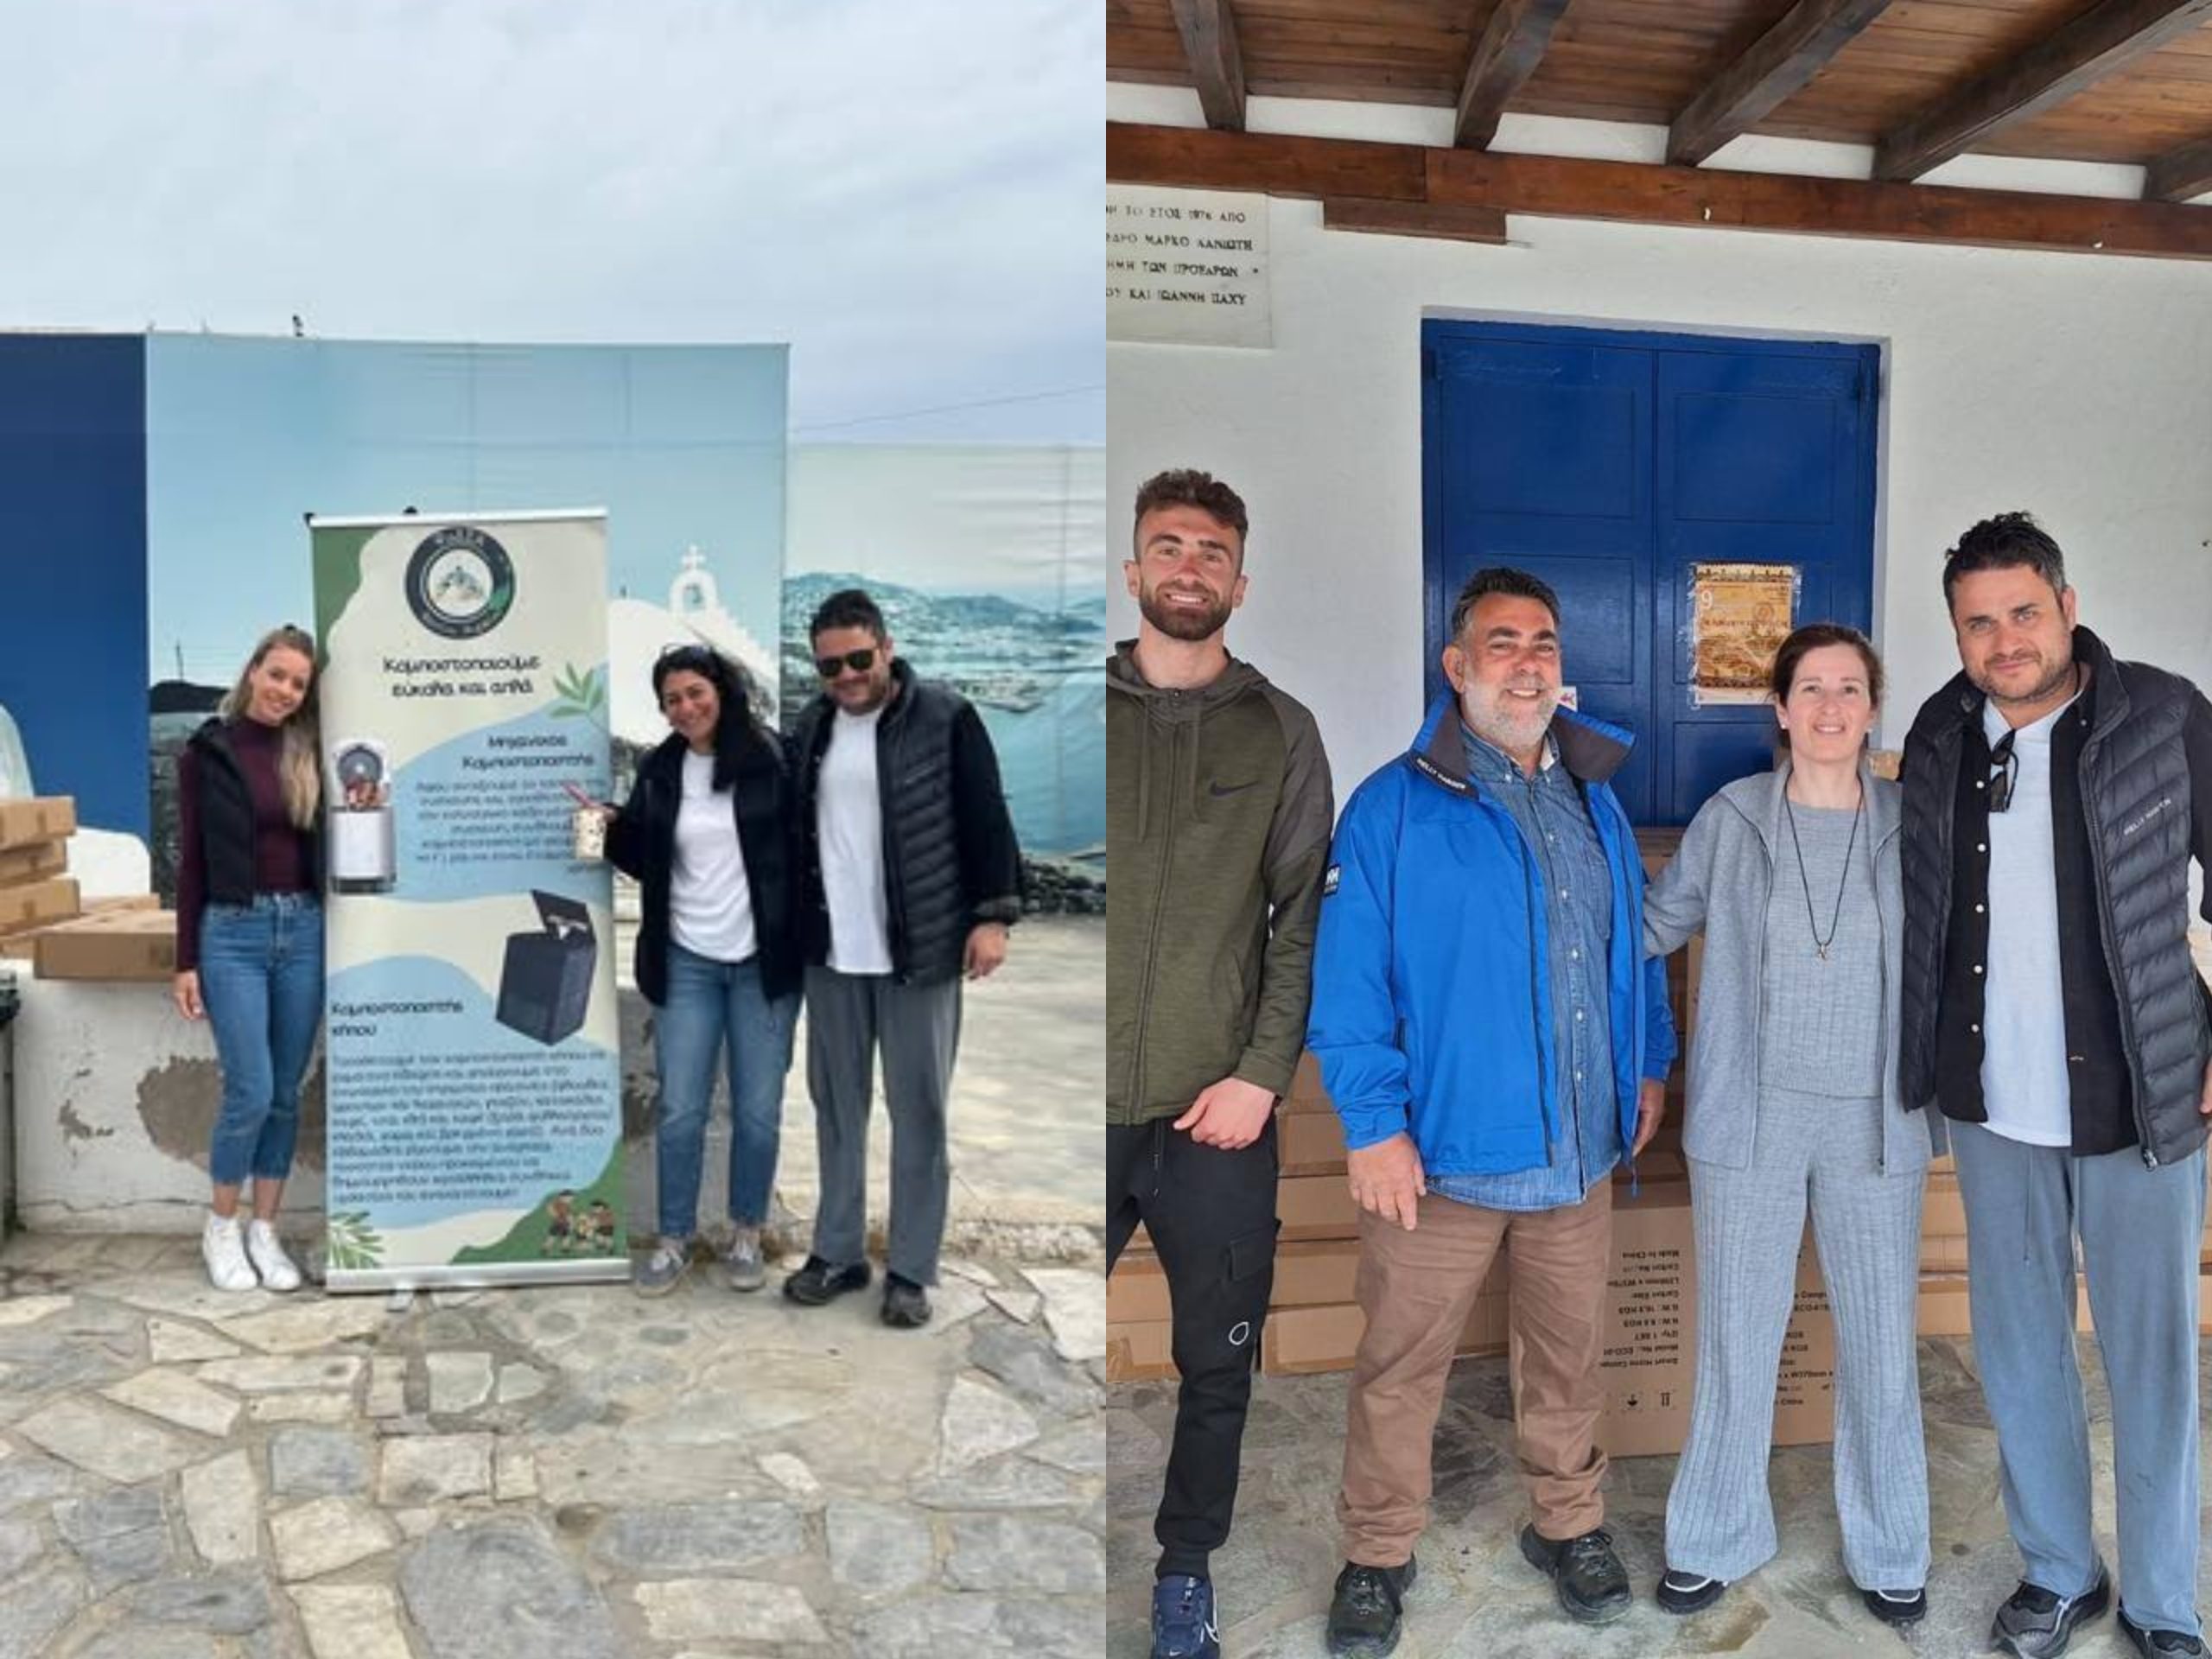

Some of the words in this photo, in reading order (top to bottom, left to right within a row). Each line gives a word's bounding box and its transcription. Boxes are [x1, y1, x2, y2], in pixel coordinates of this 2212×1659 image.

[1150, 207, 1181, 219] ΕΤΟΣ
[1220, 212, 1246, 224] ΑΠΟ
[1145, 234, 1190, 247] ΜΑΡΚΟ
[1142, 260, 1167, 273] ΤΩΝ
[1173, 263, 1239, 277] ΠΡΟΕΔΡΩΝ
[1129, 288, 1151, 301] ΚΑΙ
[1158, 289, 1205, 303] ΙΩΑΝΝΗ
[1211, 293, 1247, 306] ΠΑΧΥ
